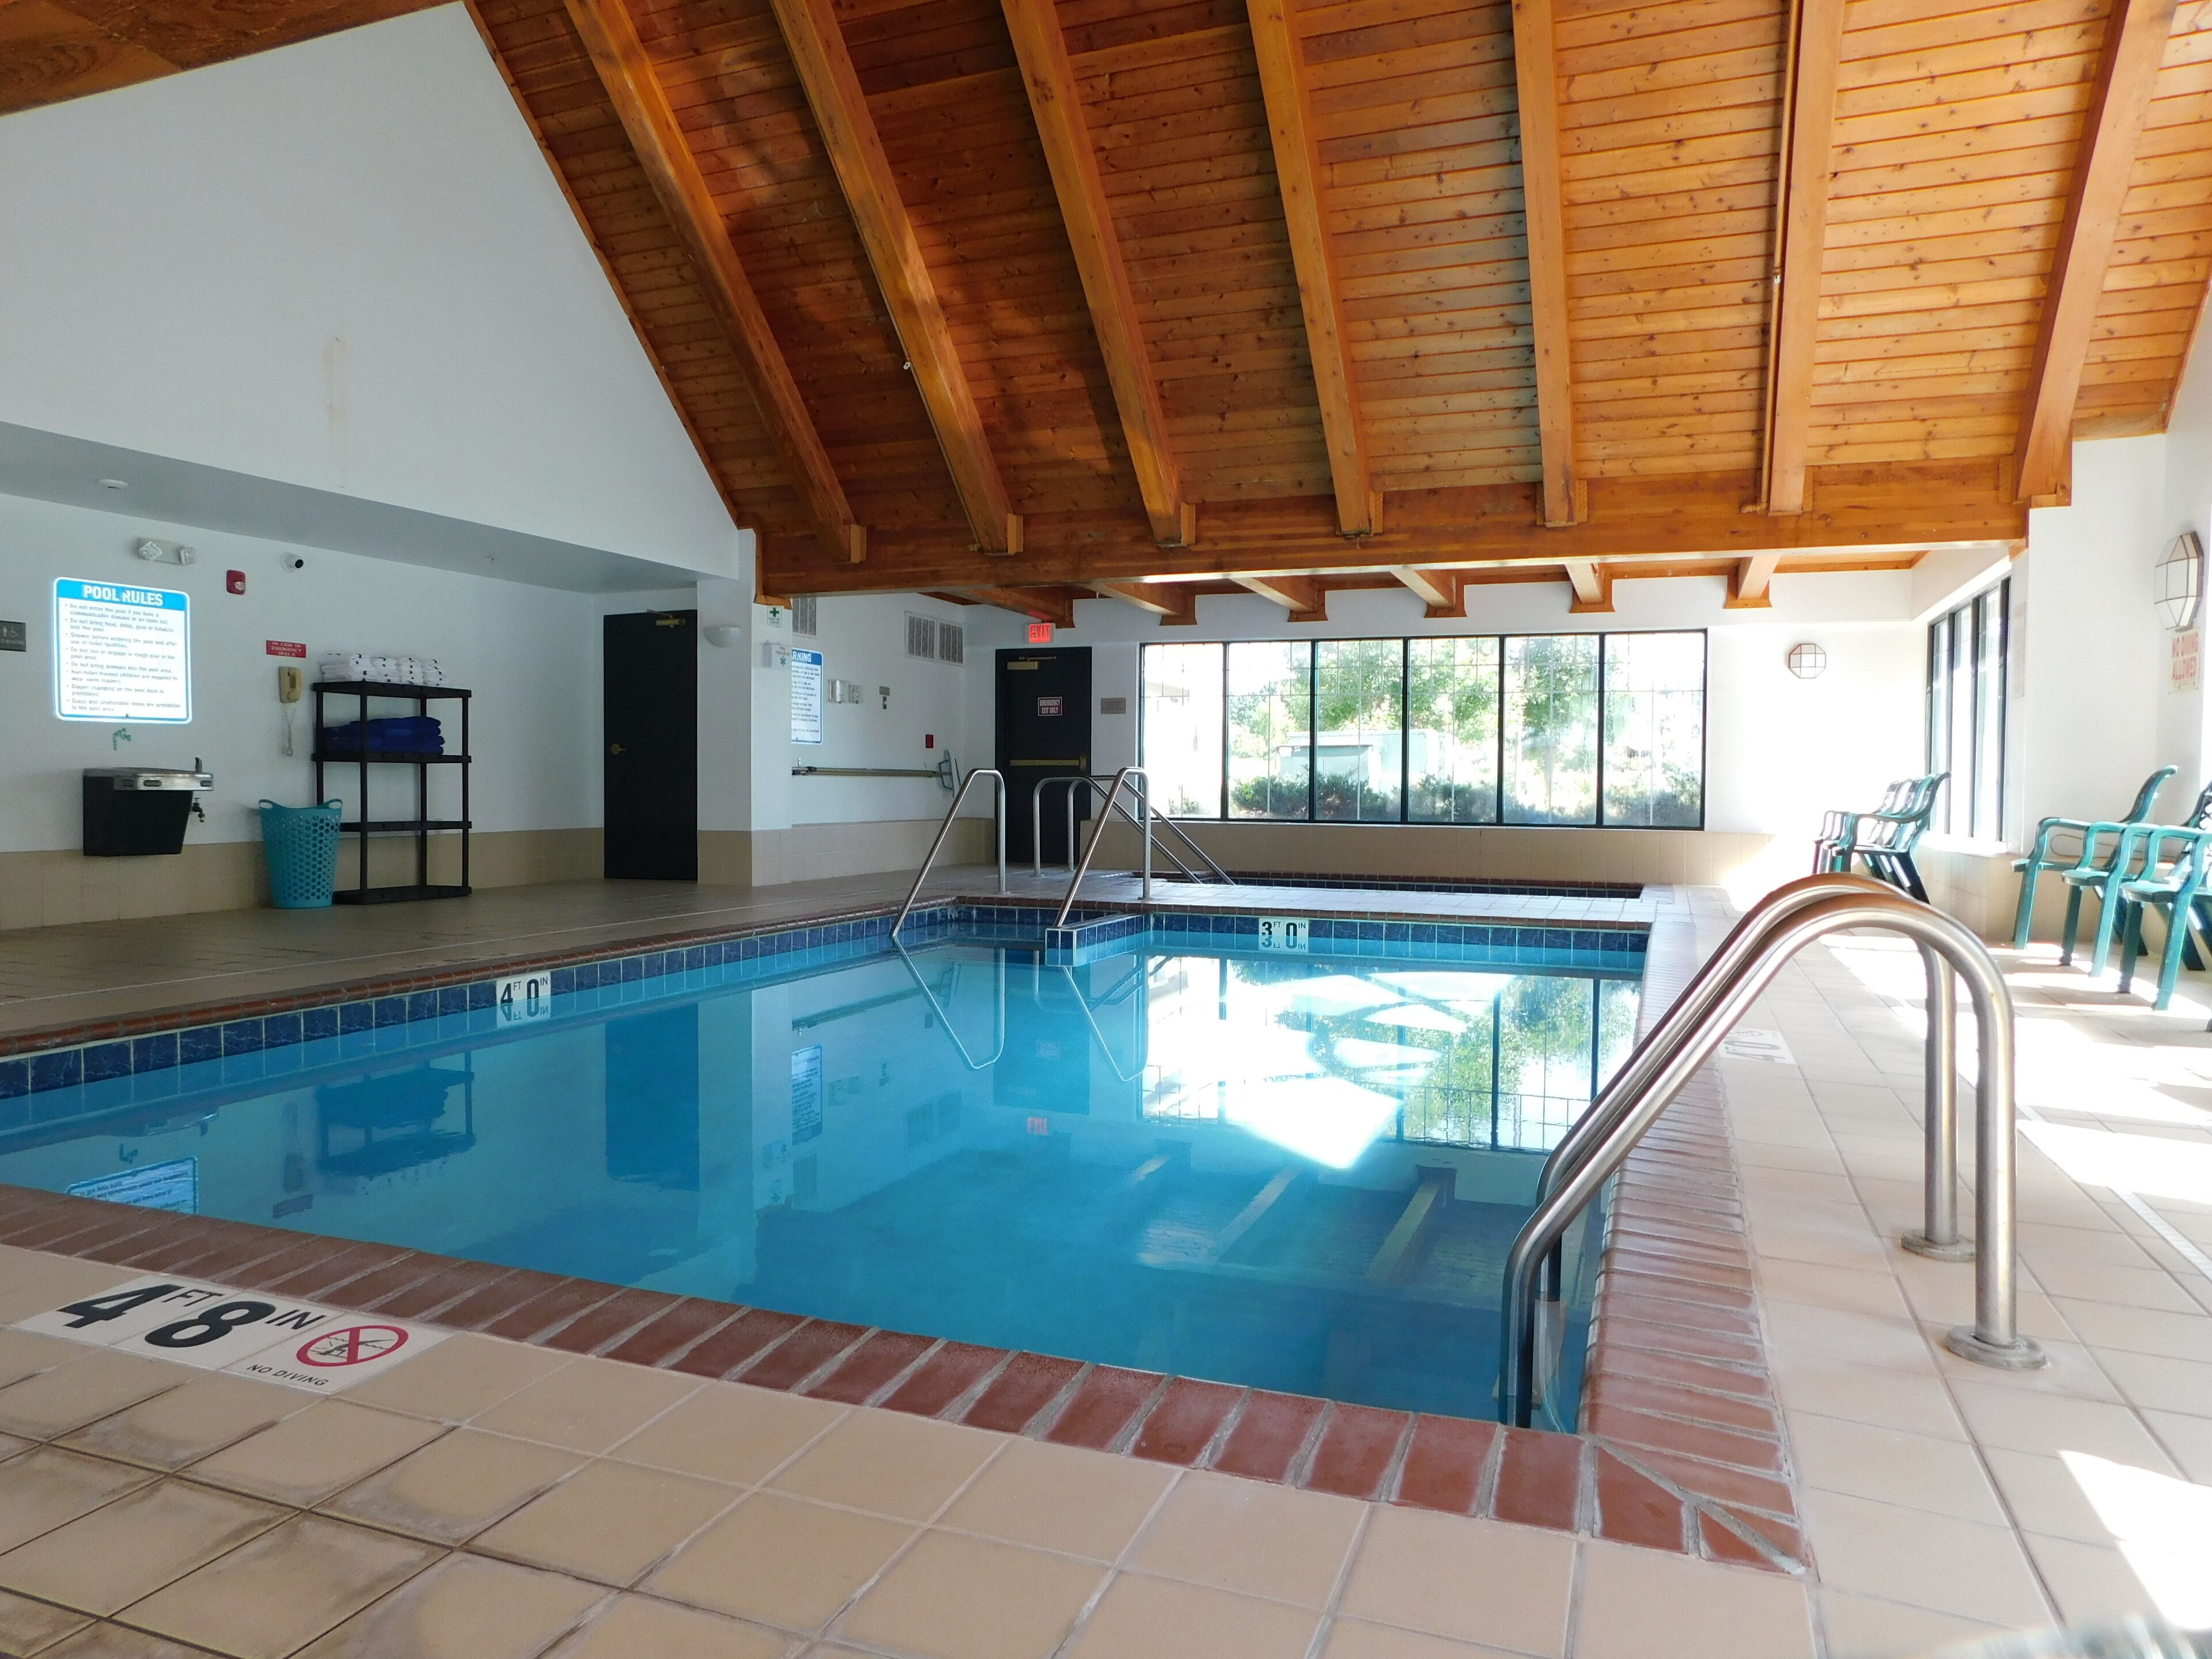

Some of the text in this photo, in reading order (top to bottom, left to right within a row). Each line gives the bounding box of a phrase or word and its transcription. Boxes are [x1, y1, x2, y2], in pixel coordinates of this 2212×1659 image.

[84, 585, 163, 606] POOL RULES
[1030, 624, 1051, 642] EXIT
[791, 652, 811, 662] RNING
[2172, 636, 2184, 658] NO
[2172, 657, 2197, 681] ALLOWED
[1262, 922, 1272, 936] 3
[1286, 922, 1297, 936] 0
[501, 976, 548, 1003] 4 FT 0 IN
[1724, 1040, 1782, 1050] 0
[56, 1283, 327, 1348] 4 FT 8 IN
[247, 1364, 329, 1387] NO DIVING
